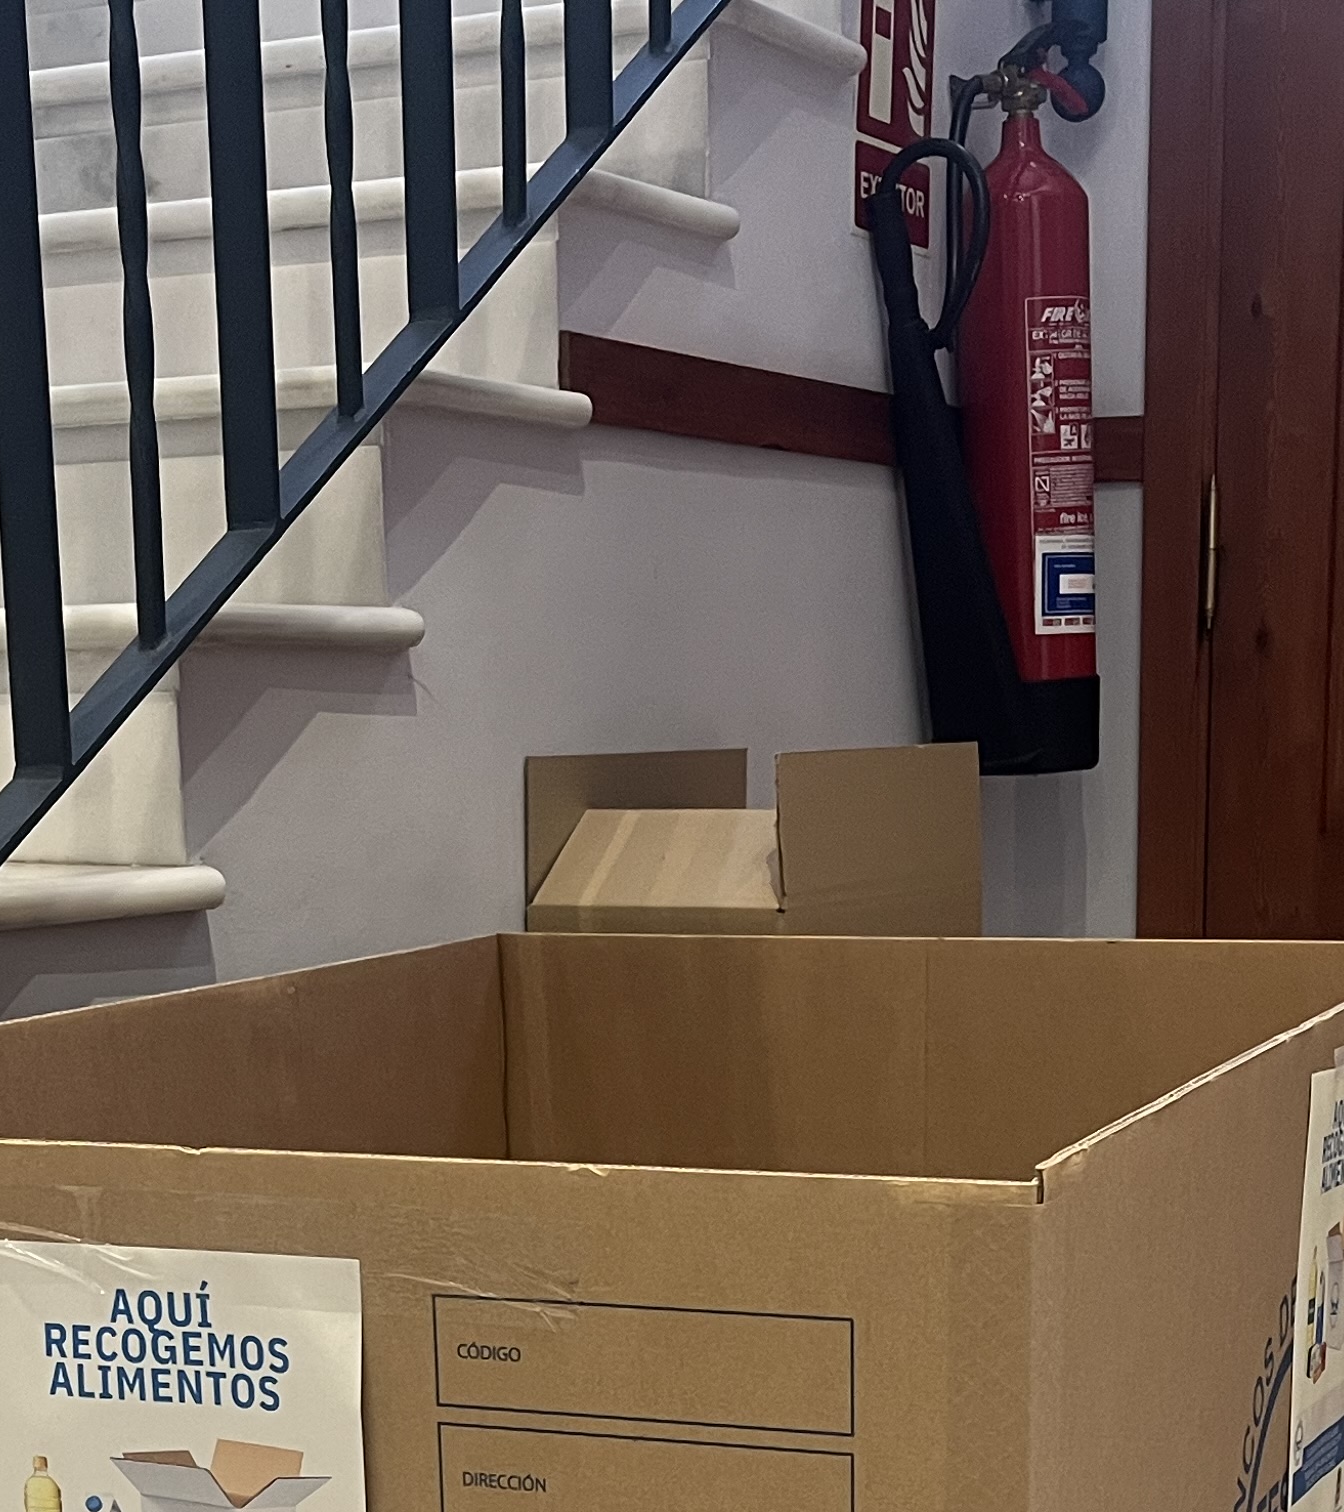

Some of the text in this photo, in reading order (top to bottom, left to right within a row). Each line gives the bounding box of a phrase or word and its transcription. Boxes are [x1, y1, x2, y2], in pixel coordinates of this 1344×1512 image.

[860, 171, 925, 218] EXTOR
[110, 1280, 212, 1331] AQUÍ
[44, 1322, 290, 1374] RECOGEMOS
[456, 1341, 522, 1363] CÓDIGO
[49, 1361, 281, 1412] ALIMENTOS
[461, 1471, 547, 1493] DIRECCIÓN
